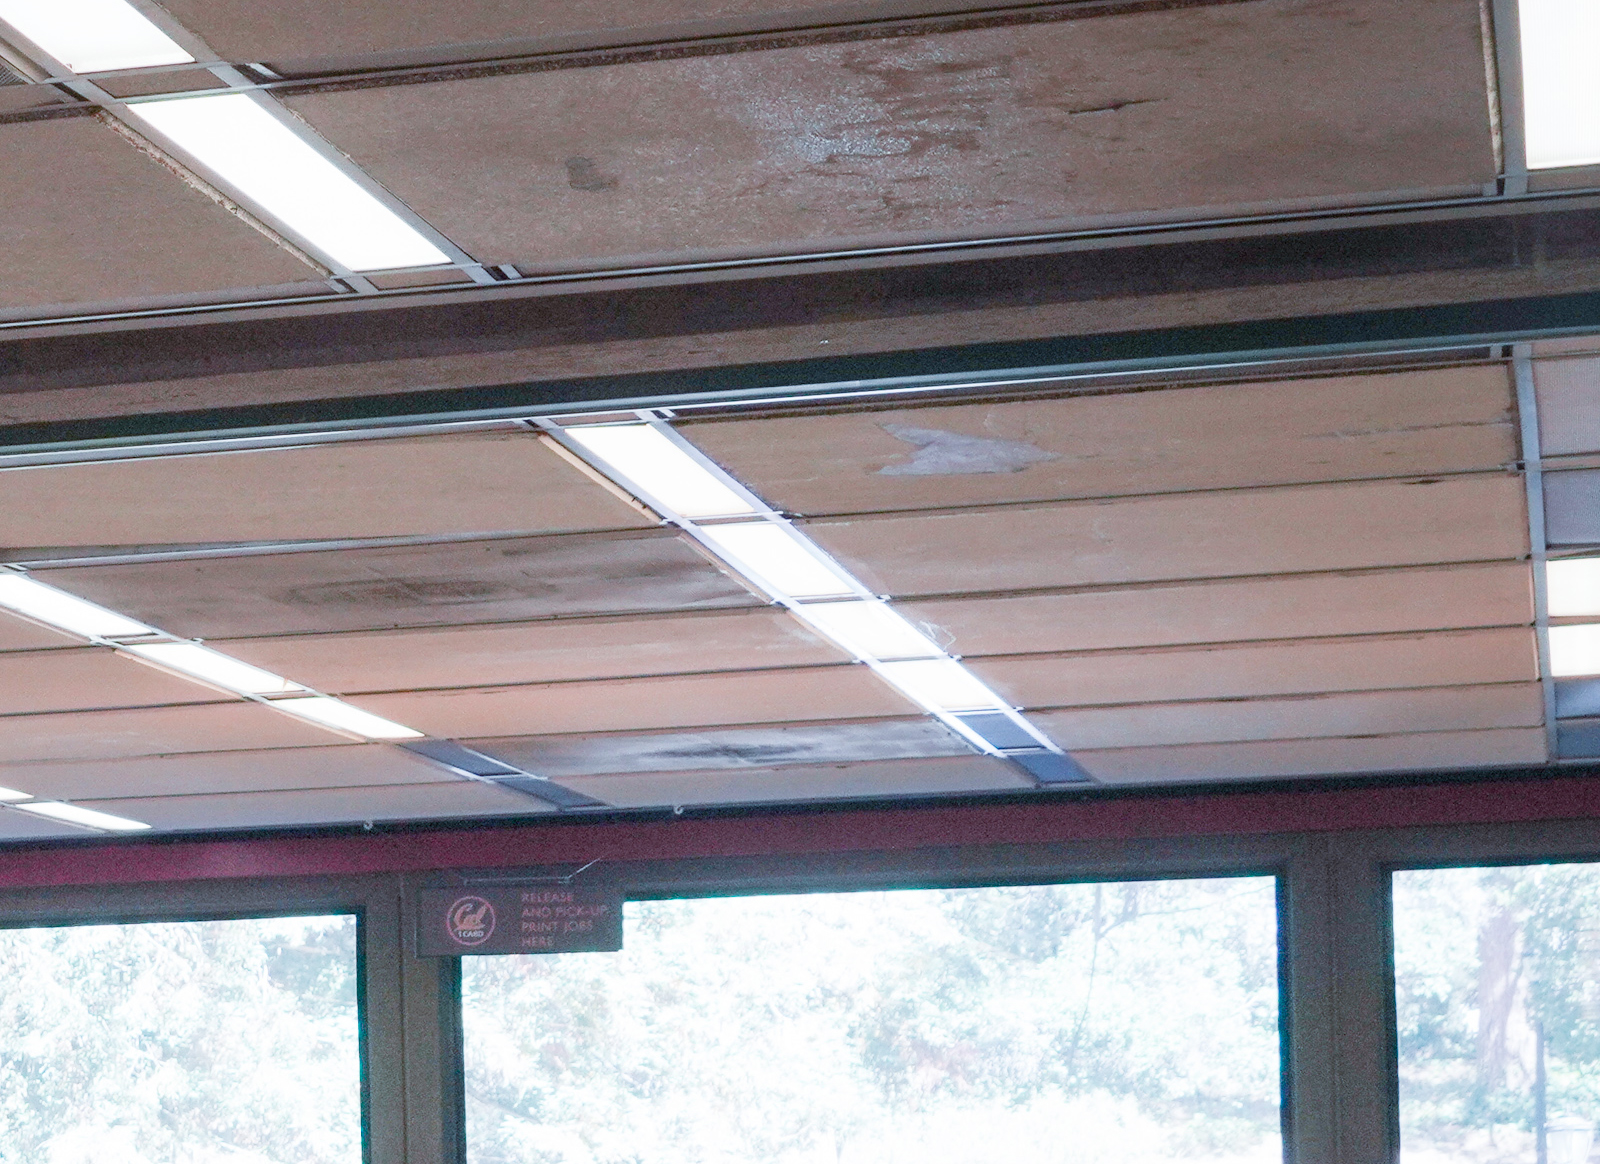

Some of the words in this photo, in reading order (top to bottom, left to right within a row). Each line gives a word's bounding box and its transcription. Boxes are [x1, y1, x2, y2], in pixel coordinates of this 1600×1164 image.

[521, 906, 551, 918] AND
[556, 904, 609, 917] PICK-UP
[521, 920, 558, 933] PRINT
[564, 919, 594, 934] JOBS
[521, 935, 555, 947] HERE
